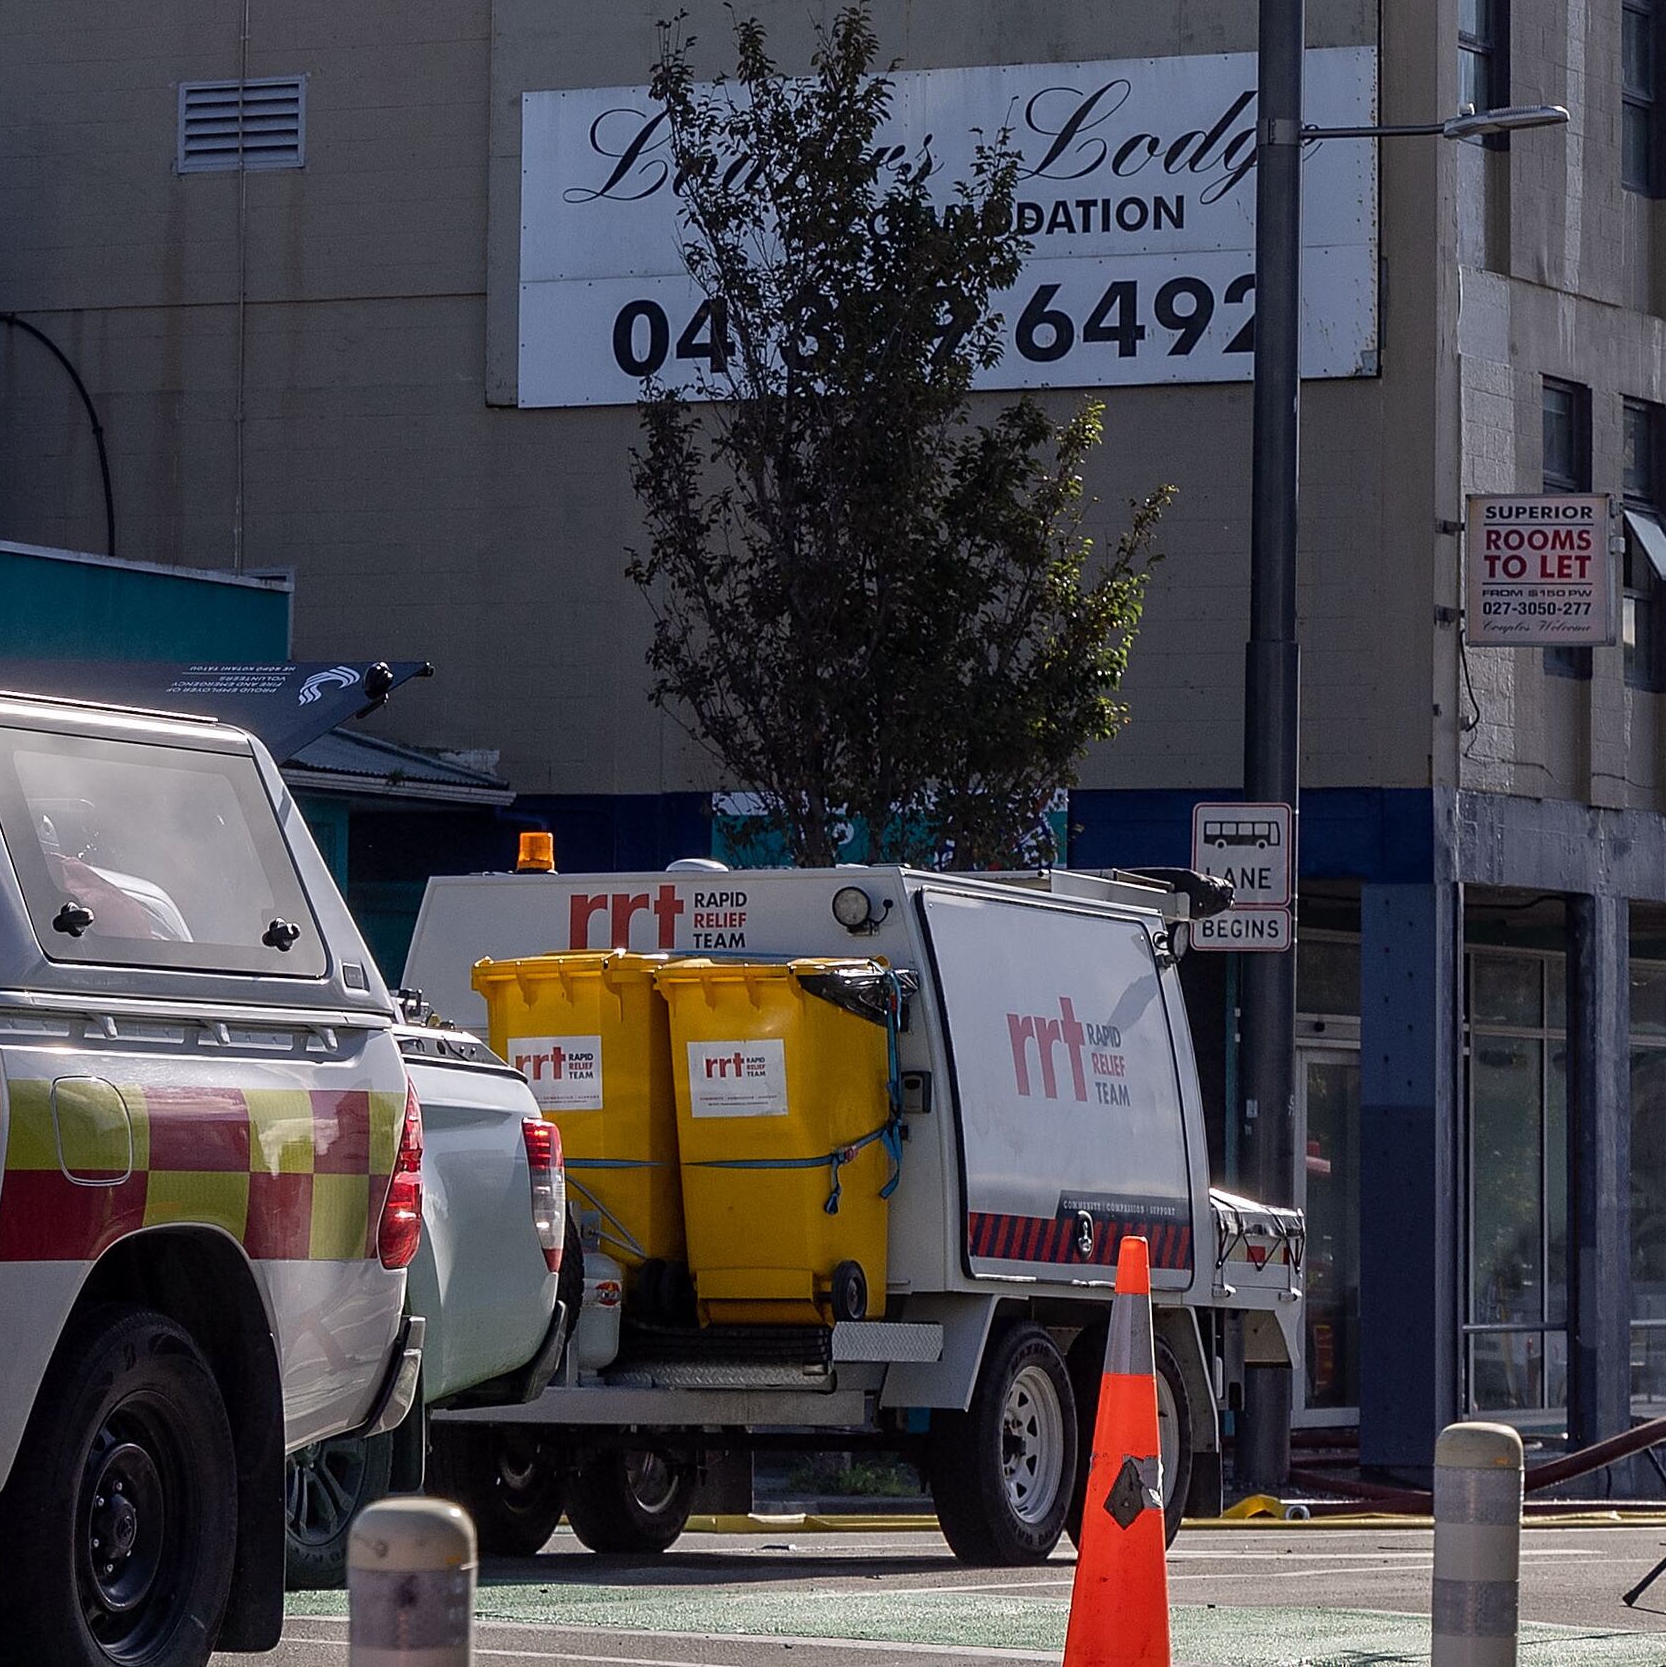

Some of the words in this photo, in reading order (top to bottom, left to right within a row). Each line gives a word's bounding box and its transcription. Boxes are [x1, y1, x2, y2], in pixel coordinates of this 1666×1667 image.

[1014, 78, 1323, 206] Lodg
[613, 298, 735, 379] 04
[1015, 273, 1255, 365] 6492
[1485, 506, 1593, 519] SUPERIOR
[1486, 529, 1592, 551] ROOMS
[1484, 555, 1527, 579] TO
[1539, 555, 1592, 579] LET
[1482, 589, 1523, 597] FROM
[1528, 589, 1566, 597] $150
[1568, 589, 1593, 597] PW
[1482, 601, 1592, 615] 027-3050-277
[1482, 619, 1530, 634] Couples
[569, 885, 684, 950] rrt
[694, 892, 747, 908] RAPID
[693, 912, 747, 929] RELIEF
[1202, 919, 1279, 939] BEGINS
[693, 932, 746, 949] TEAM
[1006, 996, 1087, 1102] rrt
[1086, 1023, 1121, 1048] RAPID
[515, 1046, 566, 1081] rrt
[569, 1053, 594, 1061] RAPID
[569, 1062, 594, 1071] RELIEF
[705, 1052, 744, 1078] rrt
[1091, 1052, 1125, 1078] RELIEF
[569, 1071, 594, 1080] TEAM
[1095, 1081, 1131, 1107] TEAM
